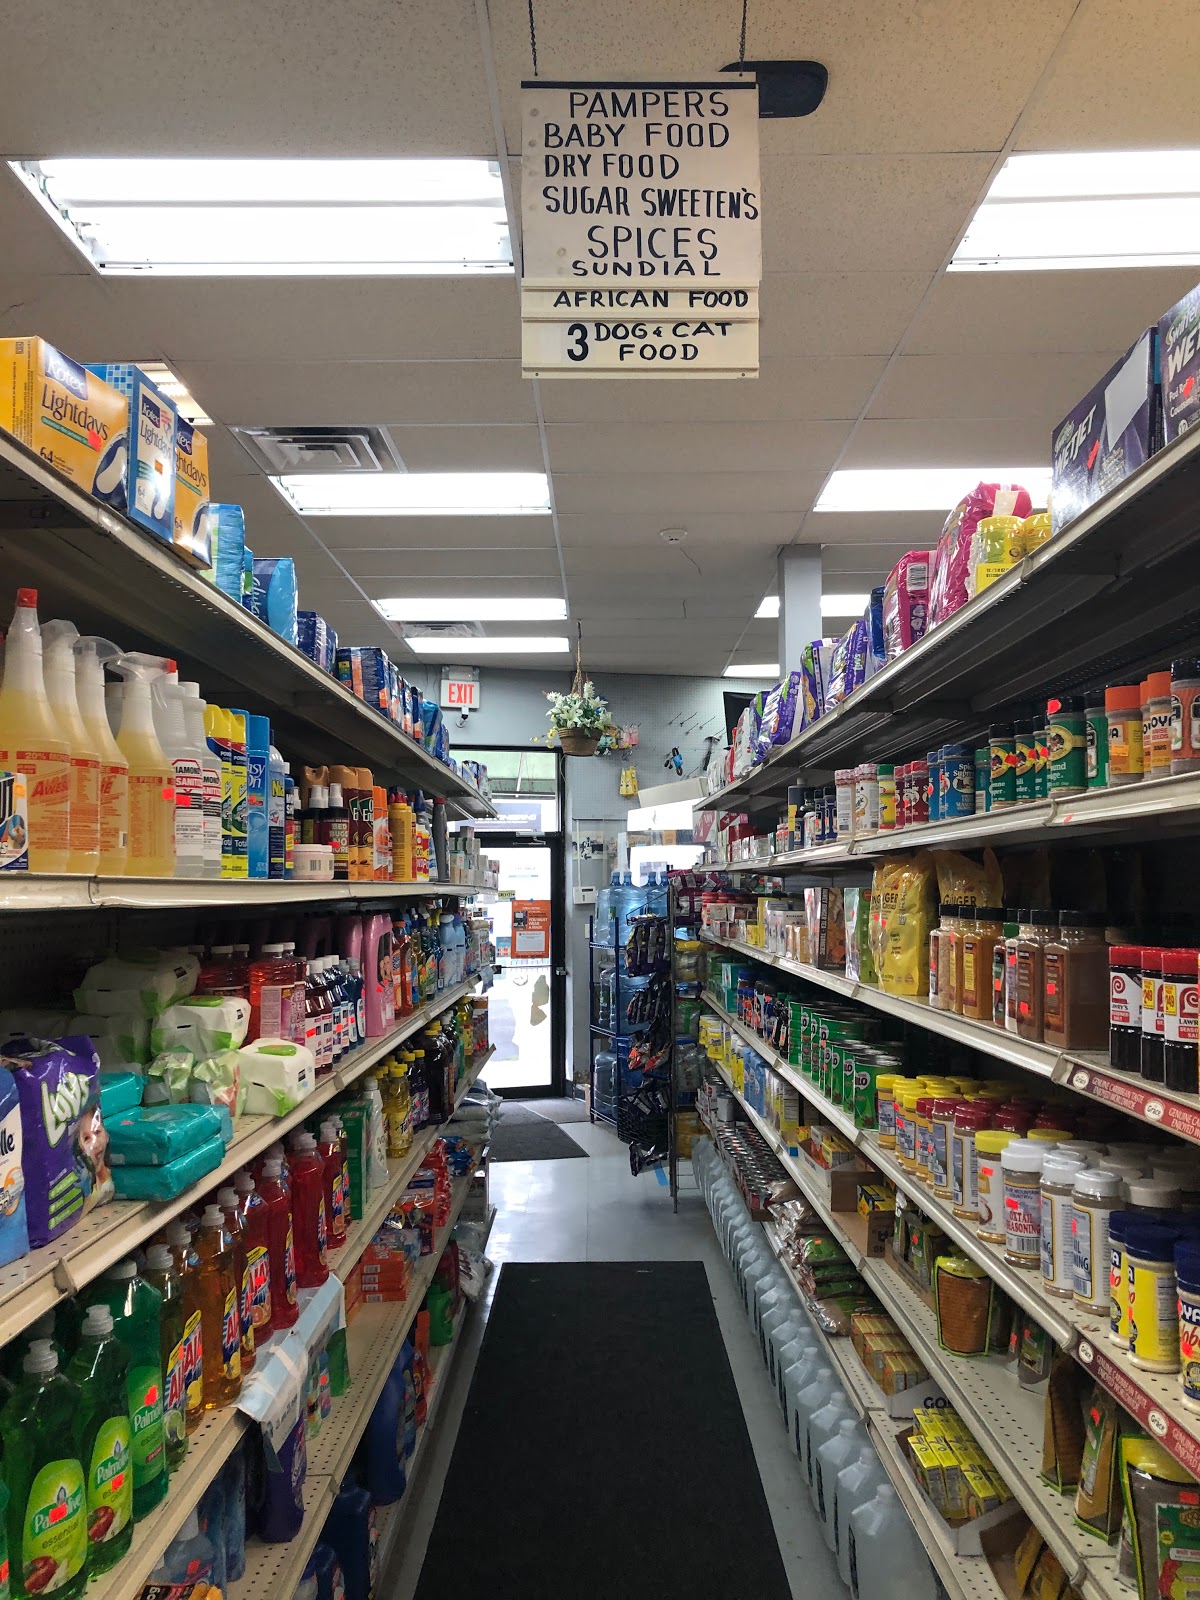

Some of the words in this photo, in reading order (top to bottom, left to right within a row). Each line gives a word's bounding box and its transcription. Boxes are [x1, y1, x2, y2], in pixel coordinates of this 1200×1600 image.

[569, 91, 729, 118] PAMPERS
[543, 122, 625, 148] BABY
[645, 122, 730, 148] FOOD
[544, 153, 592, 178] DRY
[602, 153, 680, 179] FOOD
[542, 186, 630, 216] SUGAR
[587, 225, 718, 260] SPICES
[572, 259, 721, 276] SUNDIAL
[553, 289, 669, 308] AFRICAN
[689, 289, 749, 308] FOOD
[566, 322, 589, 361] 3
[594, 322, 648, 341] DOG
[671, 322, 733, 338] CAT
[618, 344, 699, 361] FOOD
[41, 383, 110, 440] Lightdays
[140, 419, 172, 460] Lightdays
[177, 430, 192, 451] tex
[40, 446, 54, 463] 64
[175, 450, 207, 488] ghtdays
[448, 682, 474, 704] EXIT
[234, 840, 247, 848] Tota
[1131, 1092, 1145, 1104] TASTE
[41, 1072, 90, 1148] Luvs
[1147, 1105, 1161, 1117] Grace
[1168, 1107, 1192, 1124] GENUINE
[1171, 1119, 1194, 1135] ENJOYED
[1009, 1211, 1033, 1224] OXTAIL
[1150, 1413, 1165, 1431] Grace
[42, 1521, 79, 1549] essential
